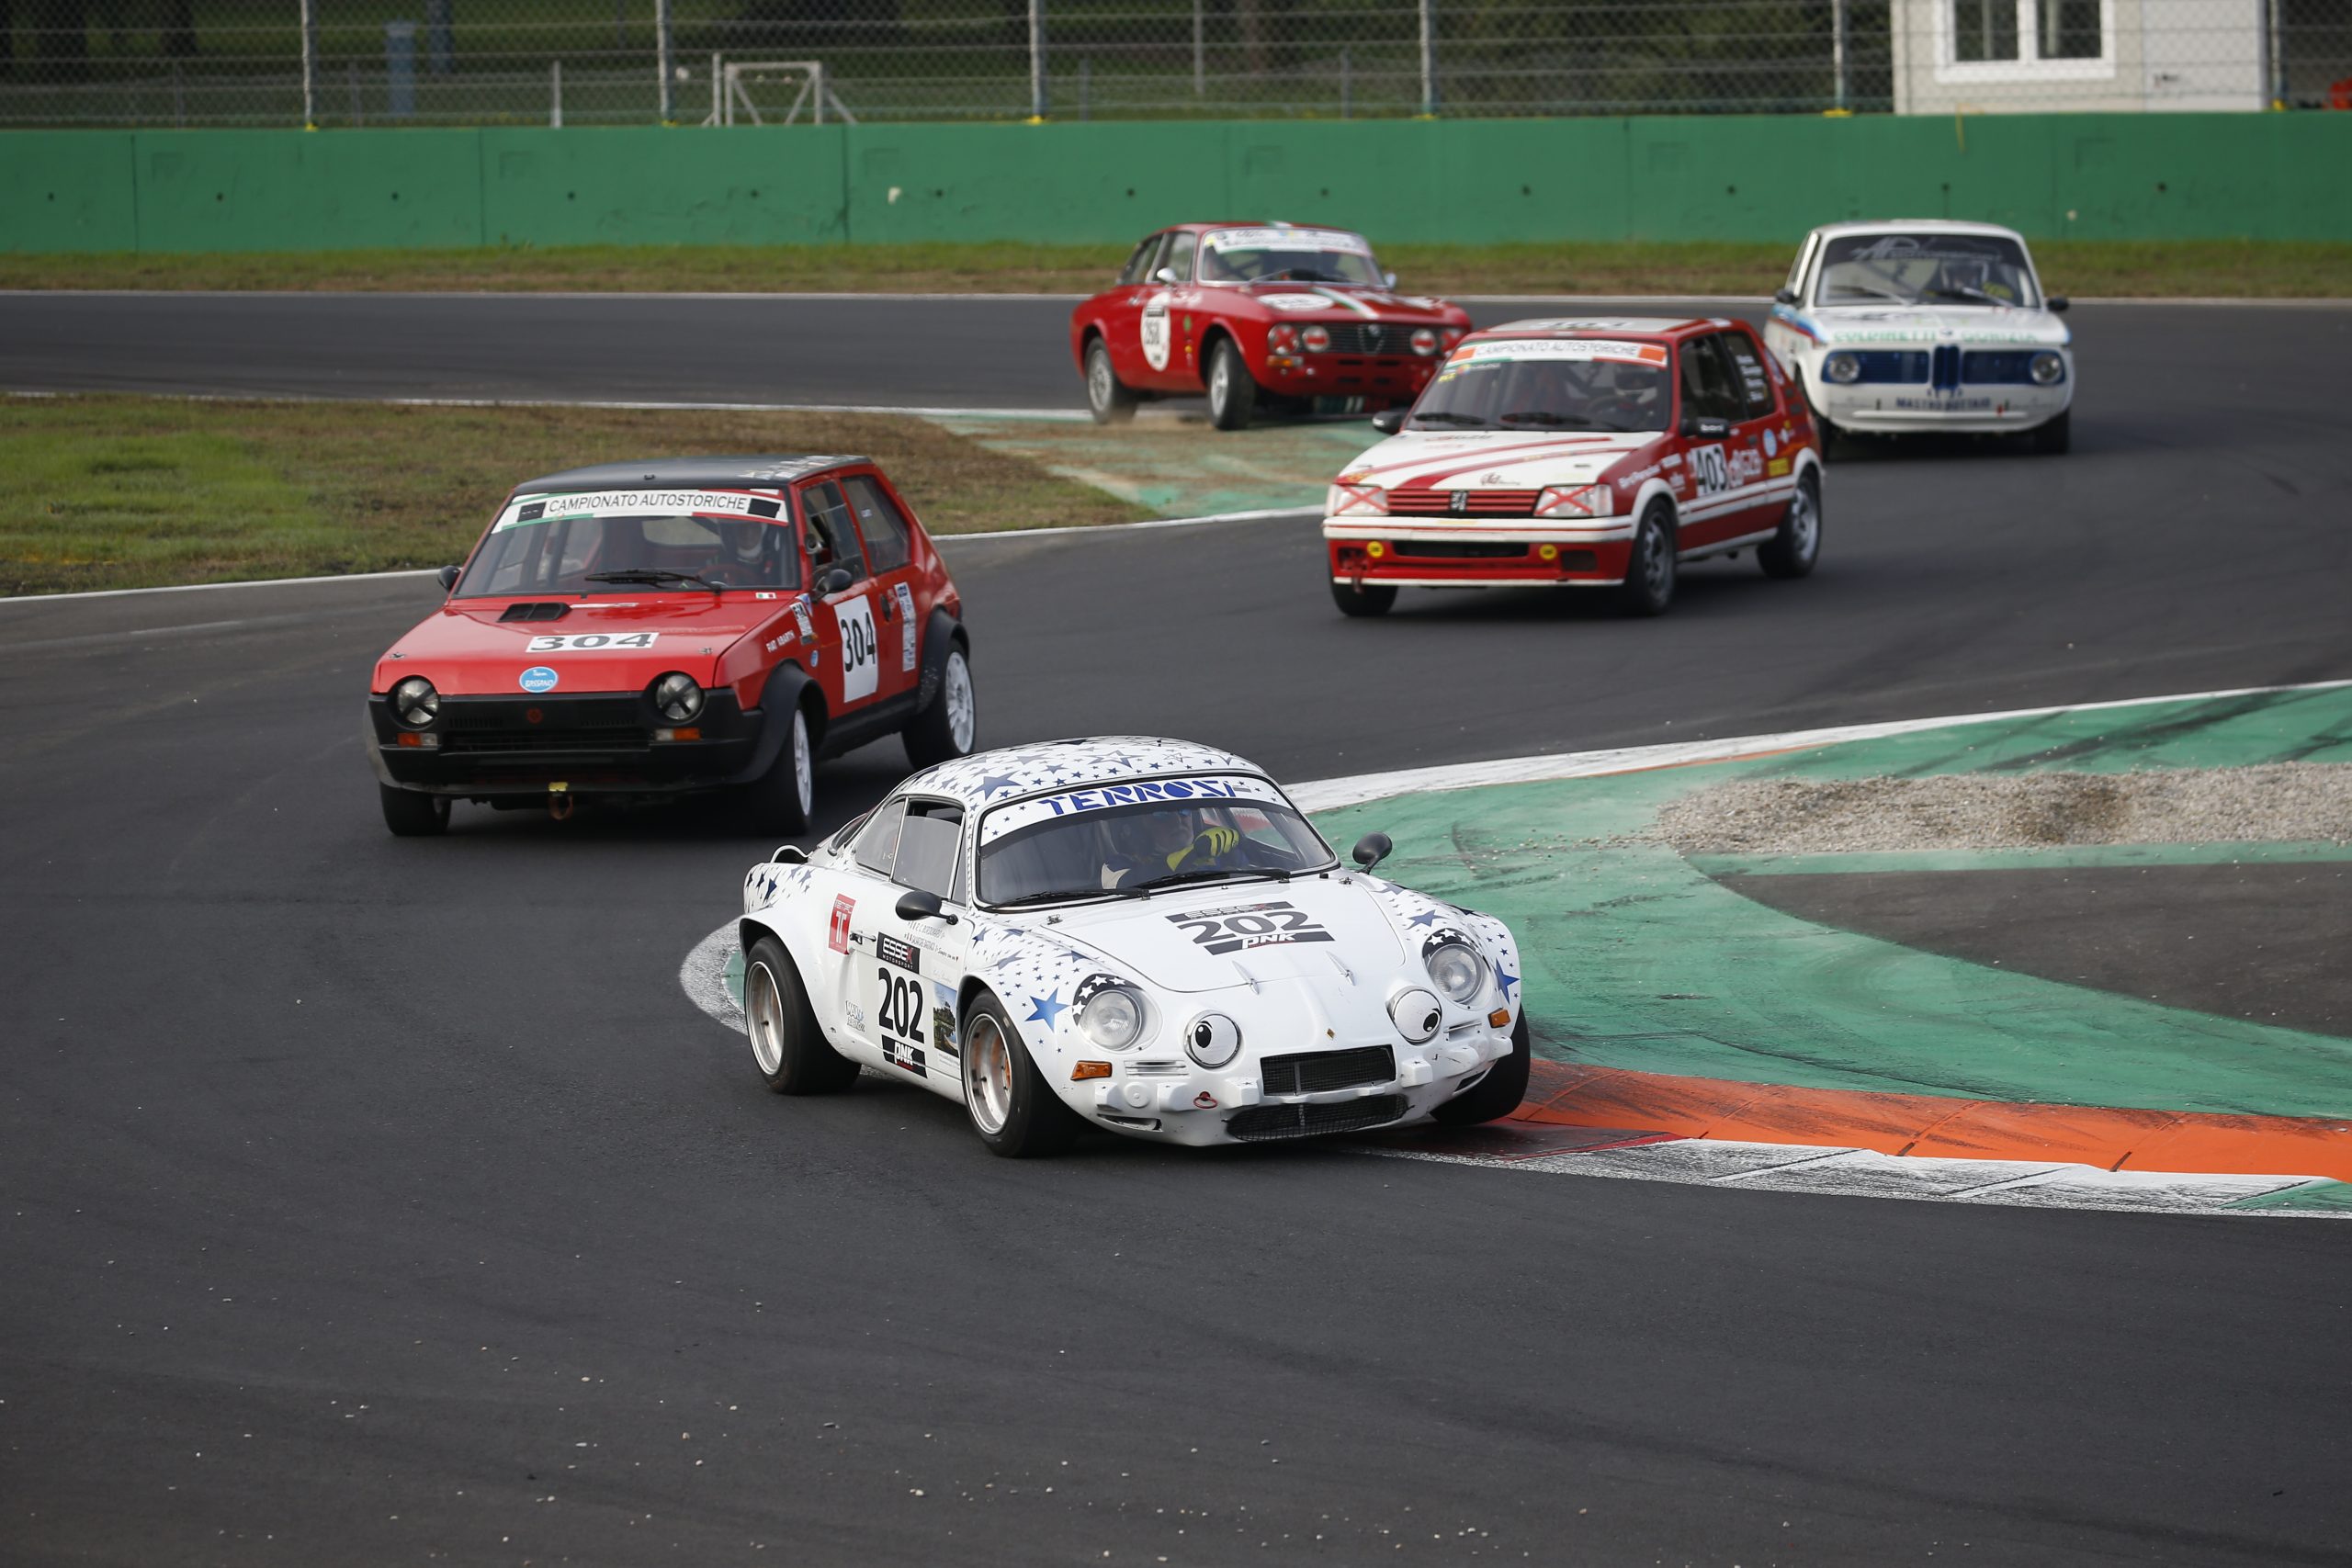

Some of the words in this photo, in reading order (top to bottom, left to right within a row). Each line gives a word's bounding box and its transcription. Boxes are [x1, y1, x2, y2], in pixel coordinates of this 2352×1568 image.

[1476, 342, 1551, 355] CAMPIONATO
[1553, 341, 1638, 355] AUTOSTORICHE
[1697, 446, 1728, 494] 403
[549, 494, 638, 513] CAMPIONATO
[639, 493, 747, 511] AUTOSTORICHE
[530, 633, 652, 651] 304
[841, 612, 876, 672] 304
[1184, 903, 1272, 919] ESSEX
[1177, 910, 1325, 944] 202
[882, 937, 914, 964] ESSEX
[882, 954, 914, 970] MOTORSPORT
[878, 966, 925, 1044] 202
